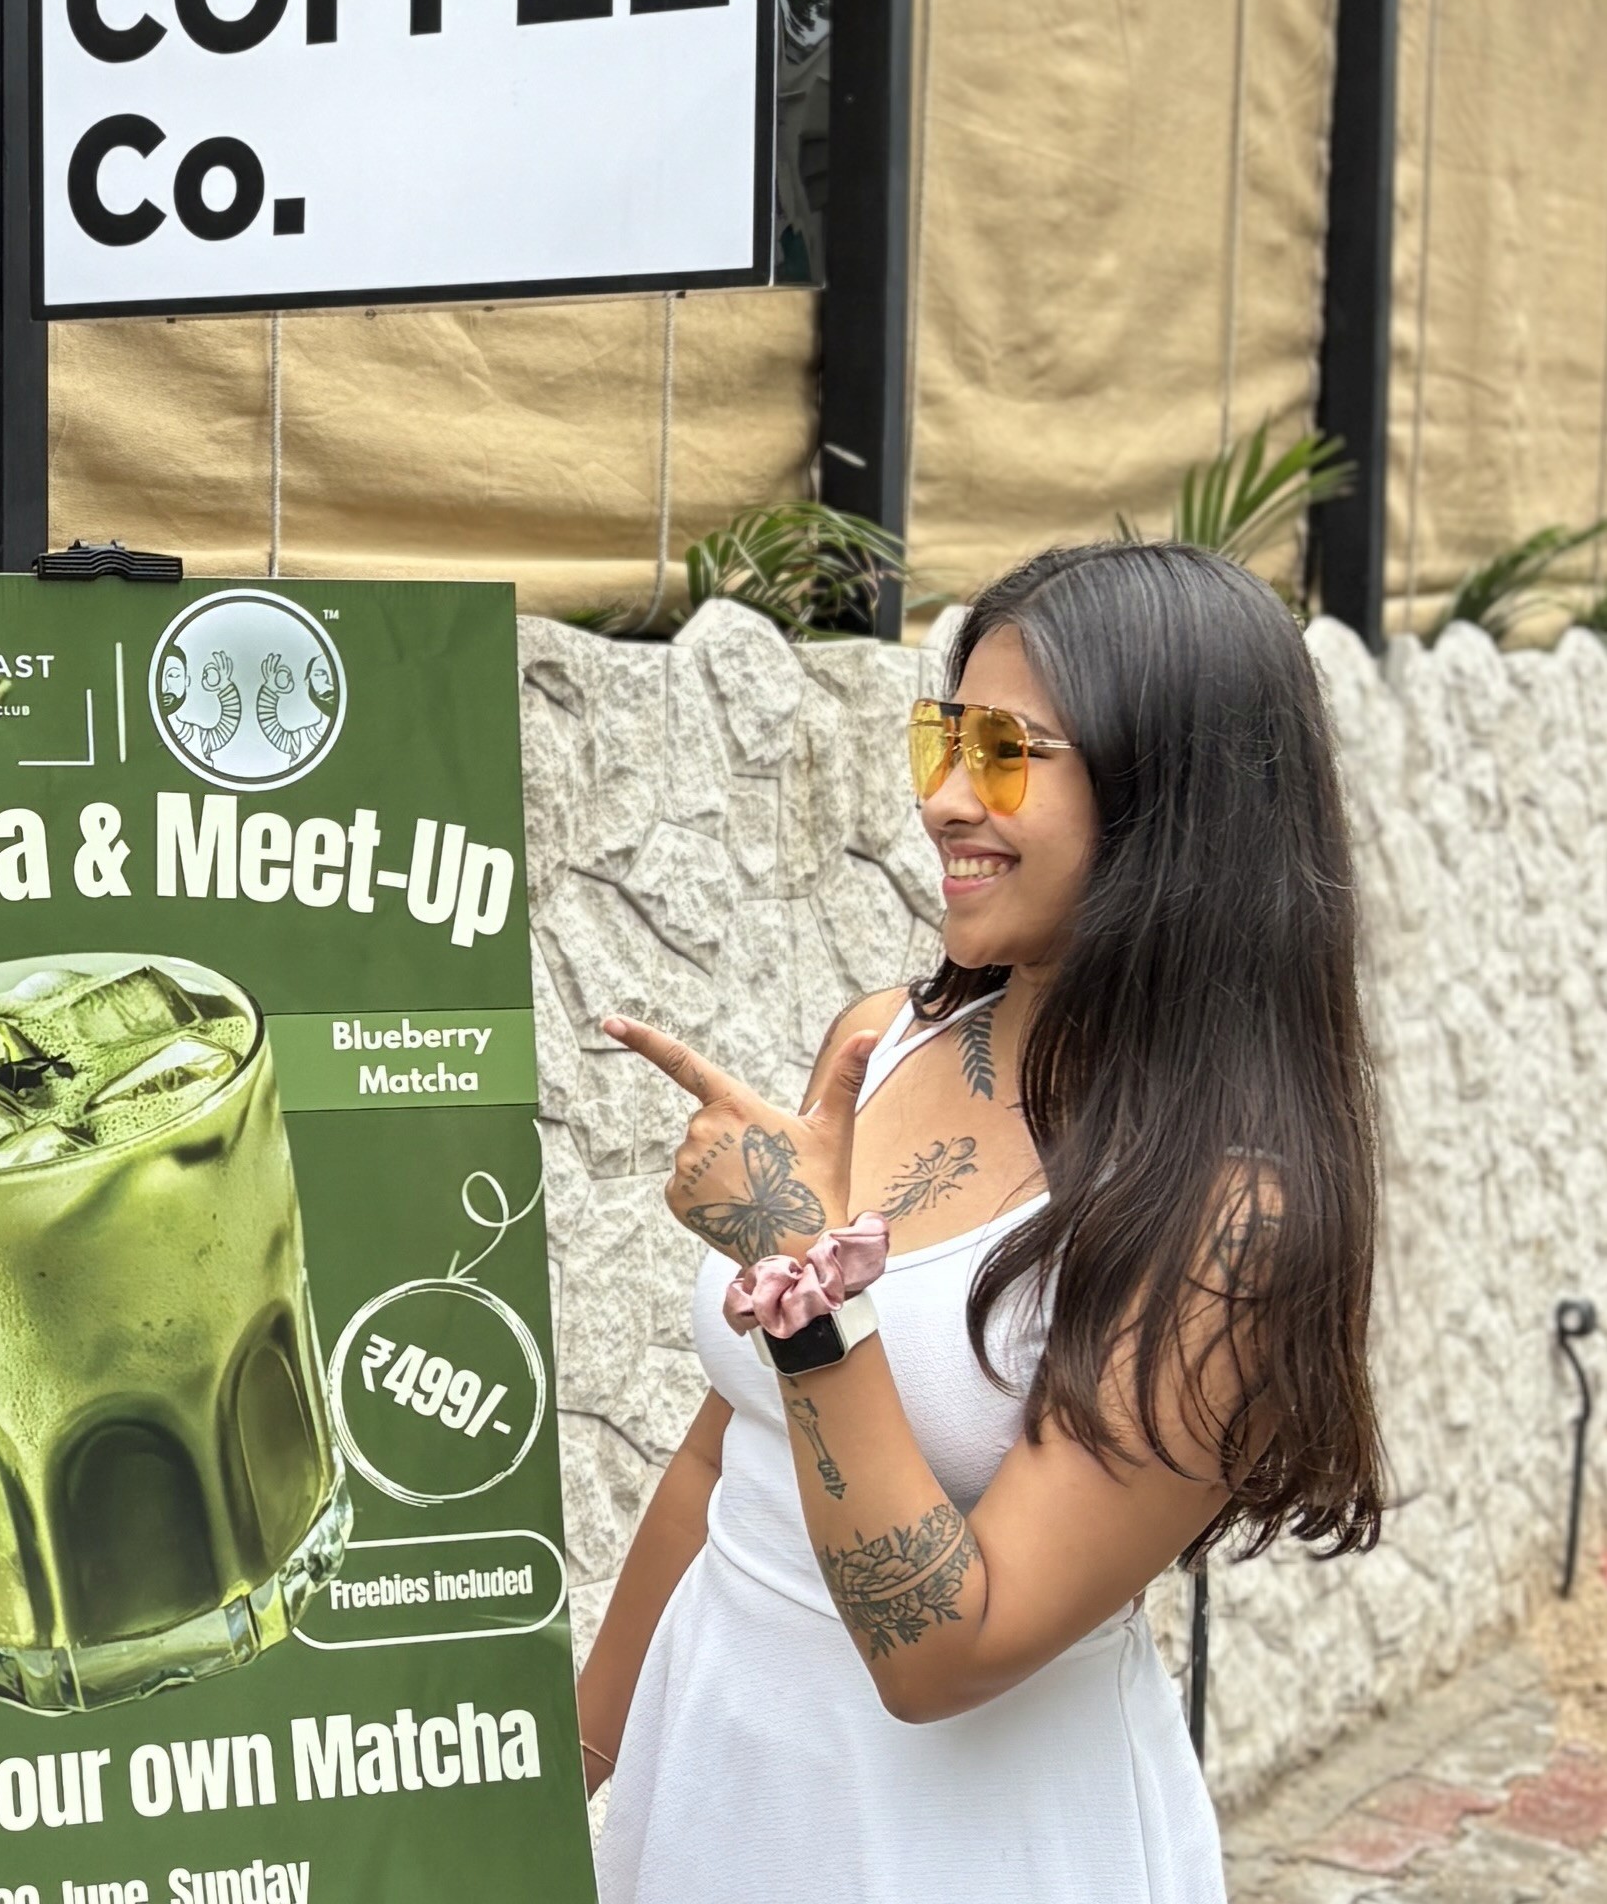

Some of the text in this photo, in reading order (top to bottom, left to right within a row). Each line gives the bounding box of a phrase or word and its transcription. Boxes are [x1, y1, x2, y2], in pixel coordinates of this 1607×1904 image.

[67, 113, 305, 247] Co.
[73, 802, 132, 898] &
[156, 791, 514, 948] Meet-Up
[332, 1018, 493, 1055] Blueberry
[359, 1062, 479, 1094] Matcha
[361, 1333, 512, 1438] ₹499/-
[330, 1564, 533, 1610] Freebies included
[129, 1733, 277, 1817] own
[290, 1702, 542, 1802] Matcha
